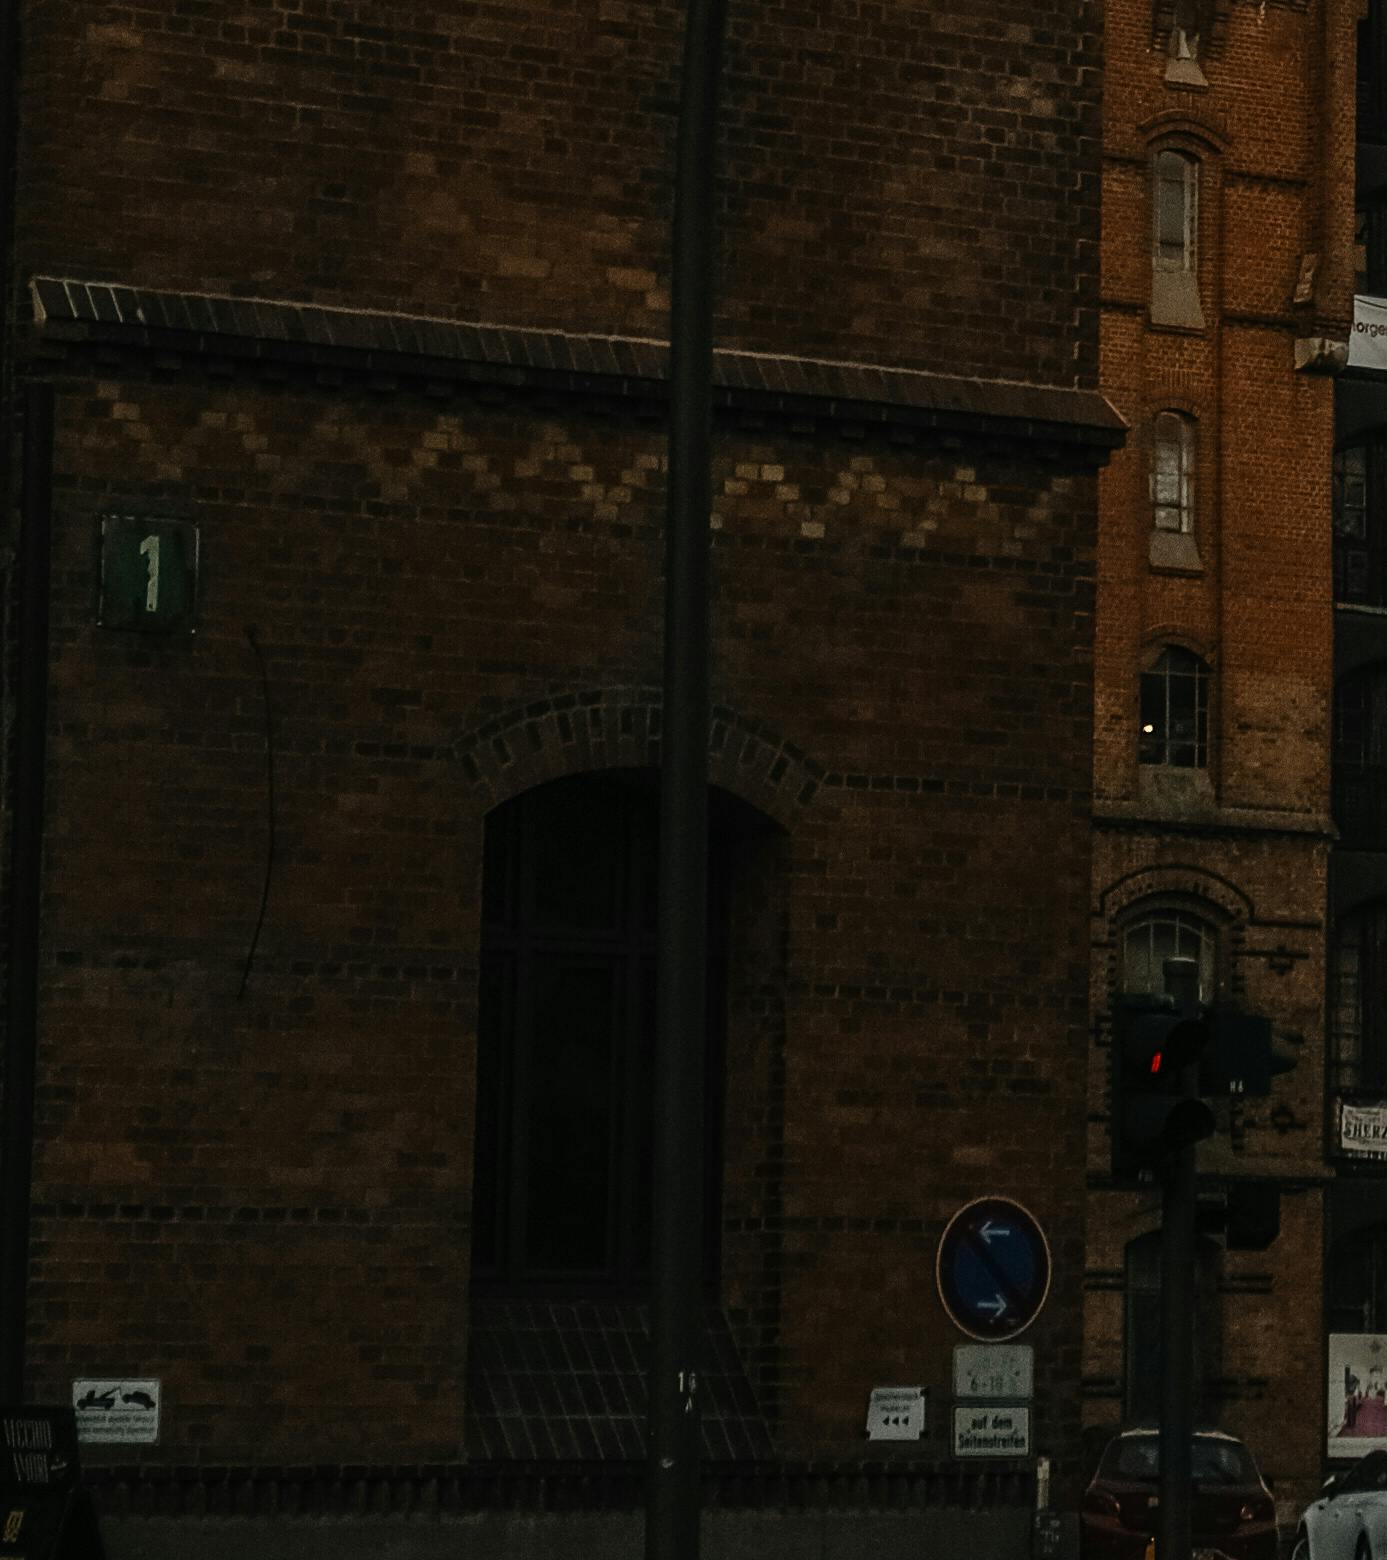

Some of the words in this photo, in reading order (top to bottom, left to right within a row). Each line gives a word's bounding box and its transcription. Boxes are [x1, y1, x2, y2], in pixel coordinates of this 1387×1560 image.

[140, 535, 160, 612] 1
[971, 1415, 987, 1429] auf
[992, 1415, 1012, 1429] dem
[959, 1434, 1026, 1449] Seitenstreifen
